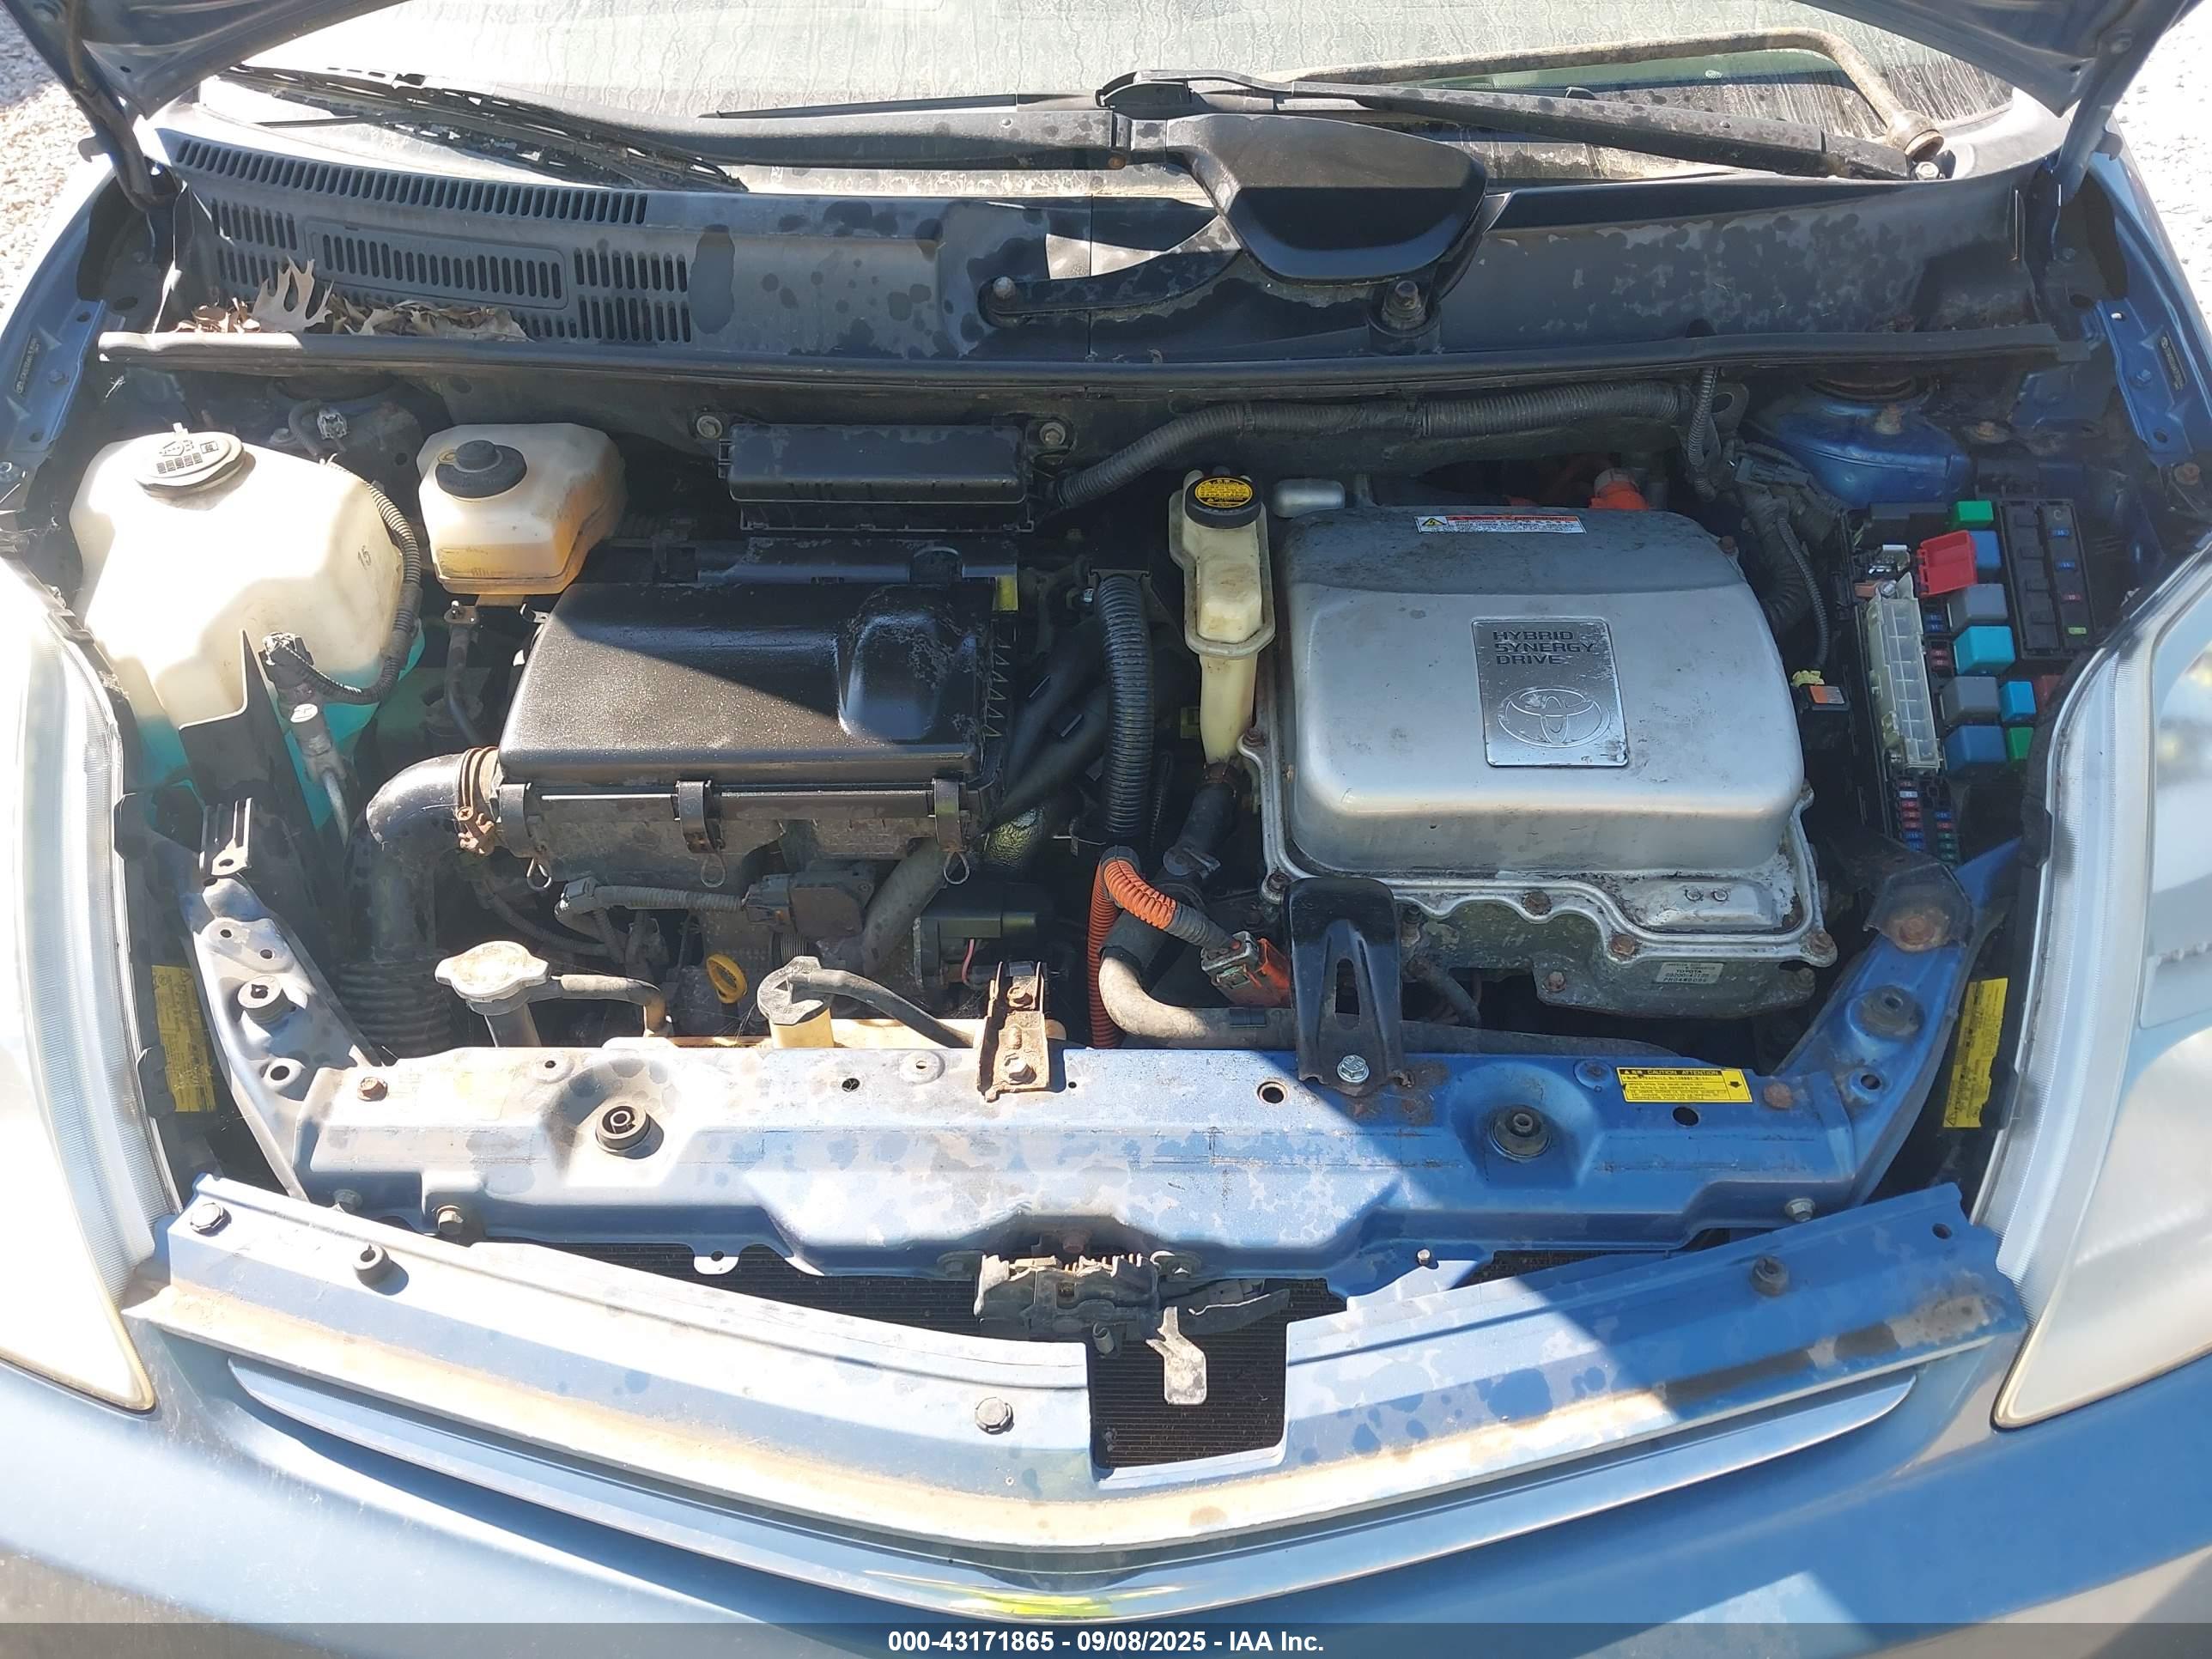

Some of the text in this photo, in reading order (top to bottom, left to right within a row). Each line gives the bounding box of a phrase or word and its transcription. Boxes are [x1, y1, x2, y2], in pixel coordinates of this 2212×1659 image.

[1492, 631, 1574, 641] HYBRID
[1494, 642, 1595, 653] SYNERGY
[1496, 654, 1563, 665] DRIVE
